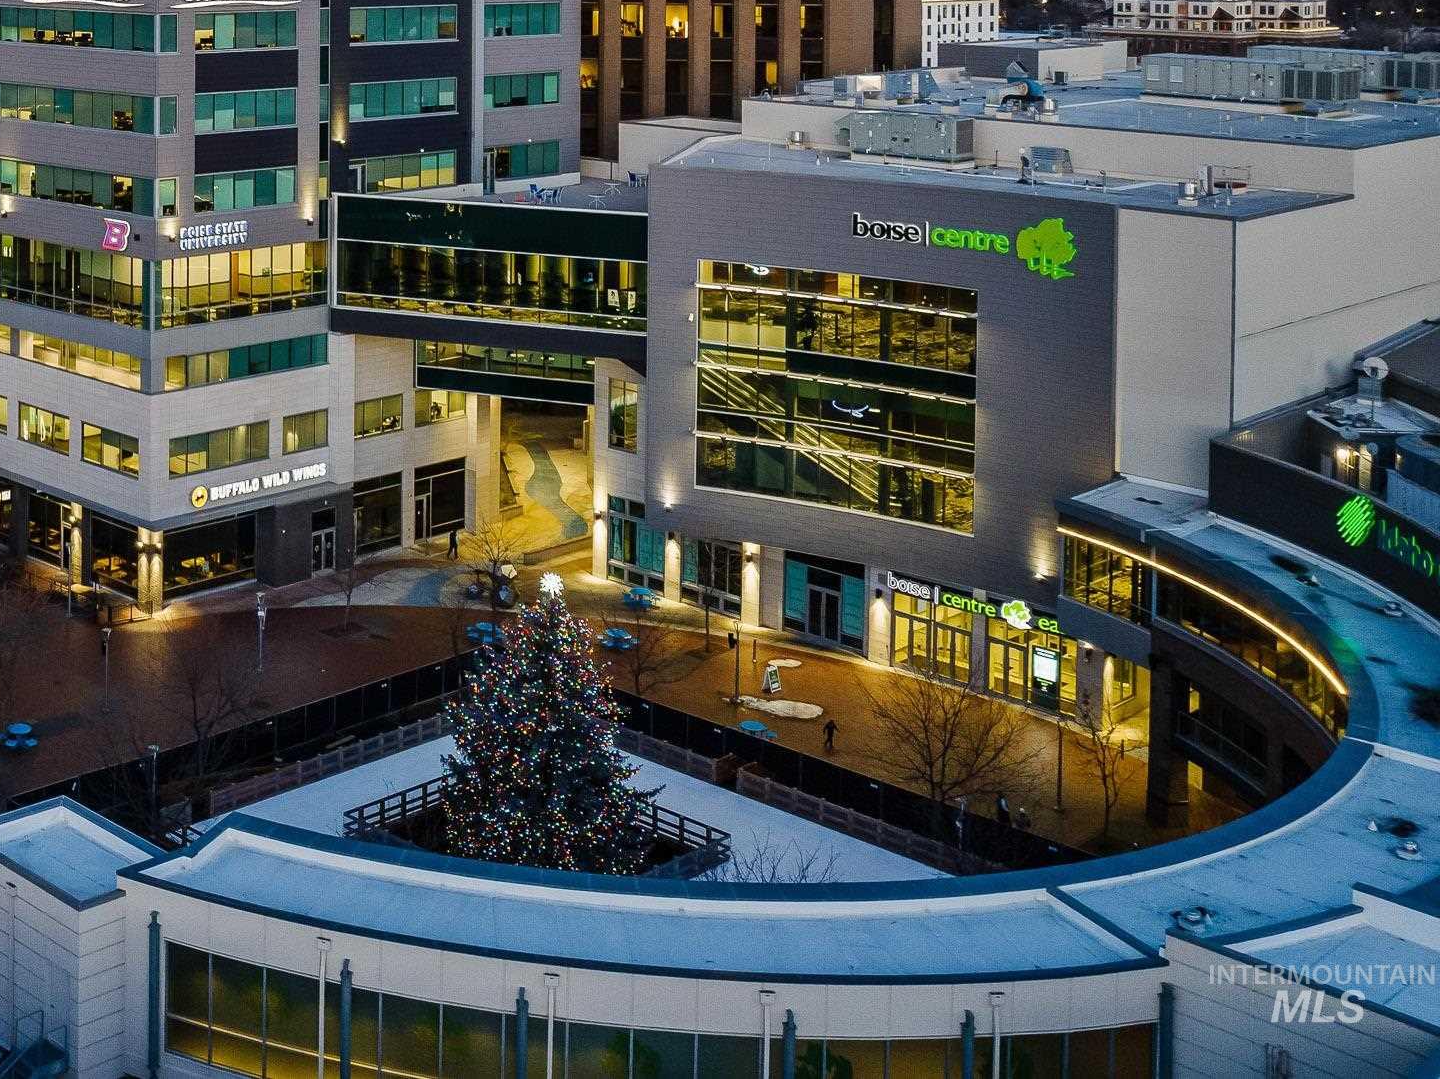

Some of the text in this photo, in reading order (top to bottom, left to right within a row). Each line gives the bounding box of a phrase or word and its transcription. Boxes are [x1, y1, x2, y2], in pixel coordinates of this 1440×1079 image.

[101, 217, 131, 252] B
[852, 211, 1009, 254] boise centre
[210, 462, 328, 501] BUFFALO WILD WINGS
[887, 571, 931, 600] boise
[942, 593, 997, 618] centre
